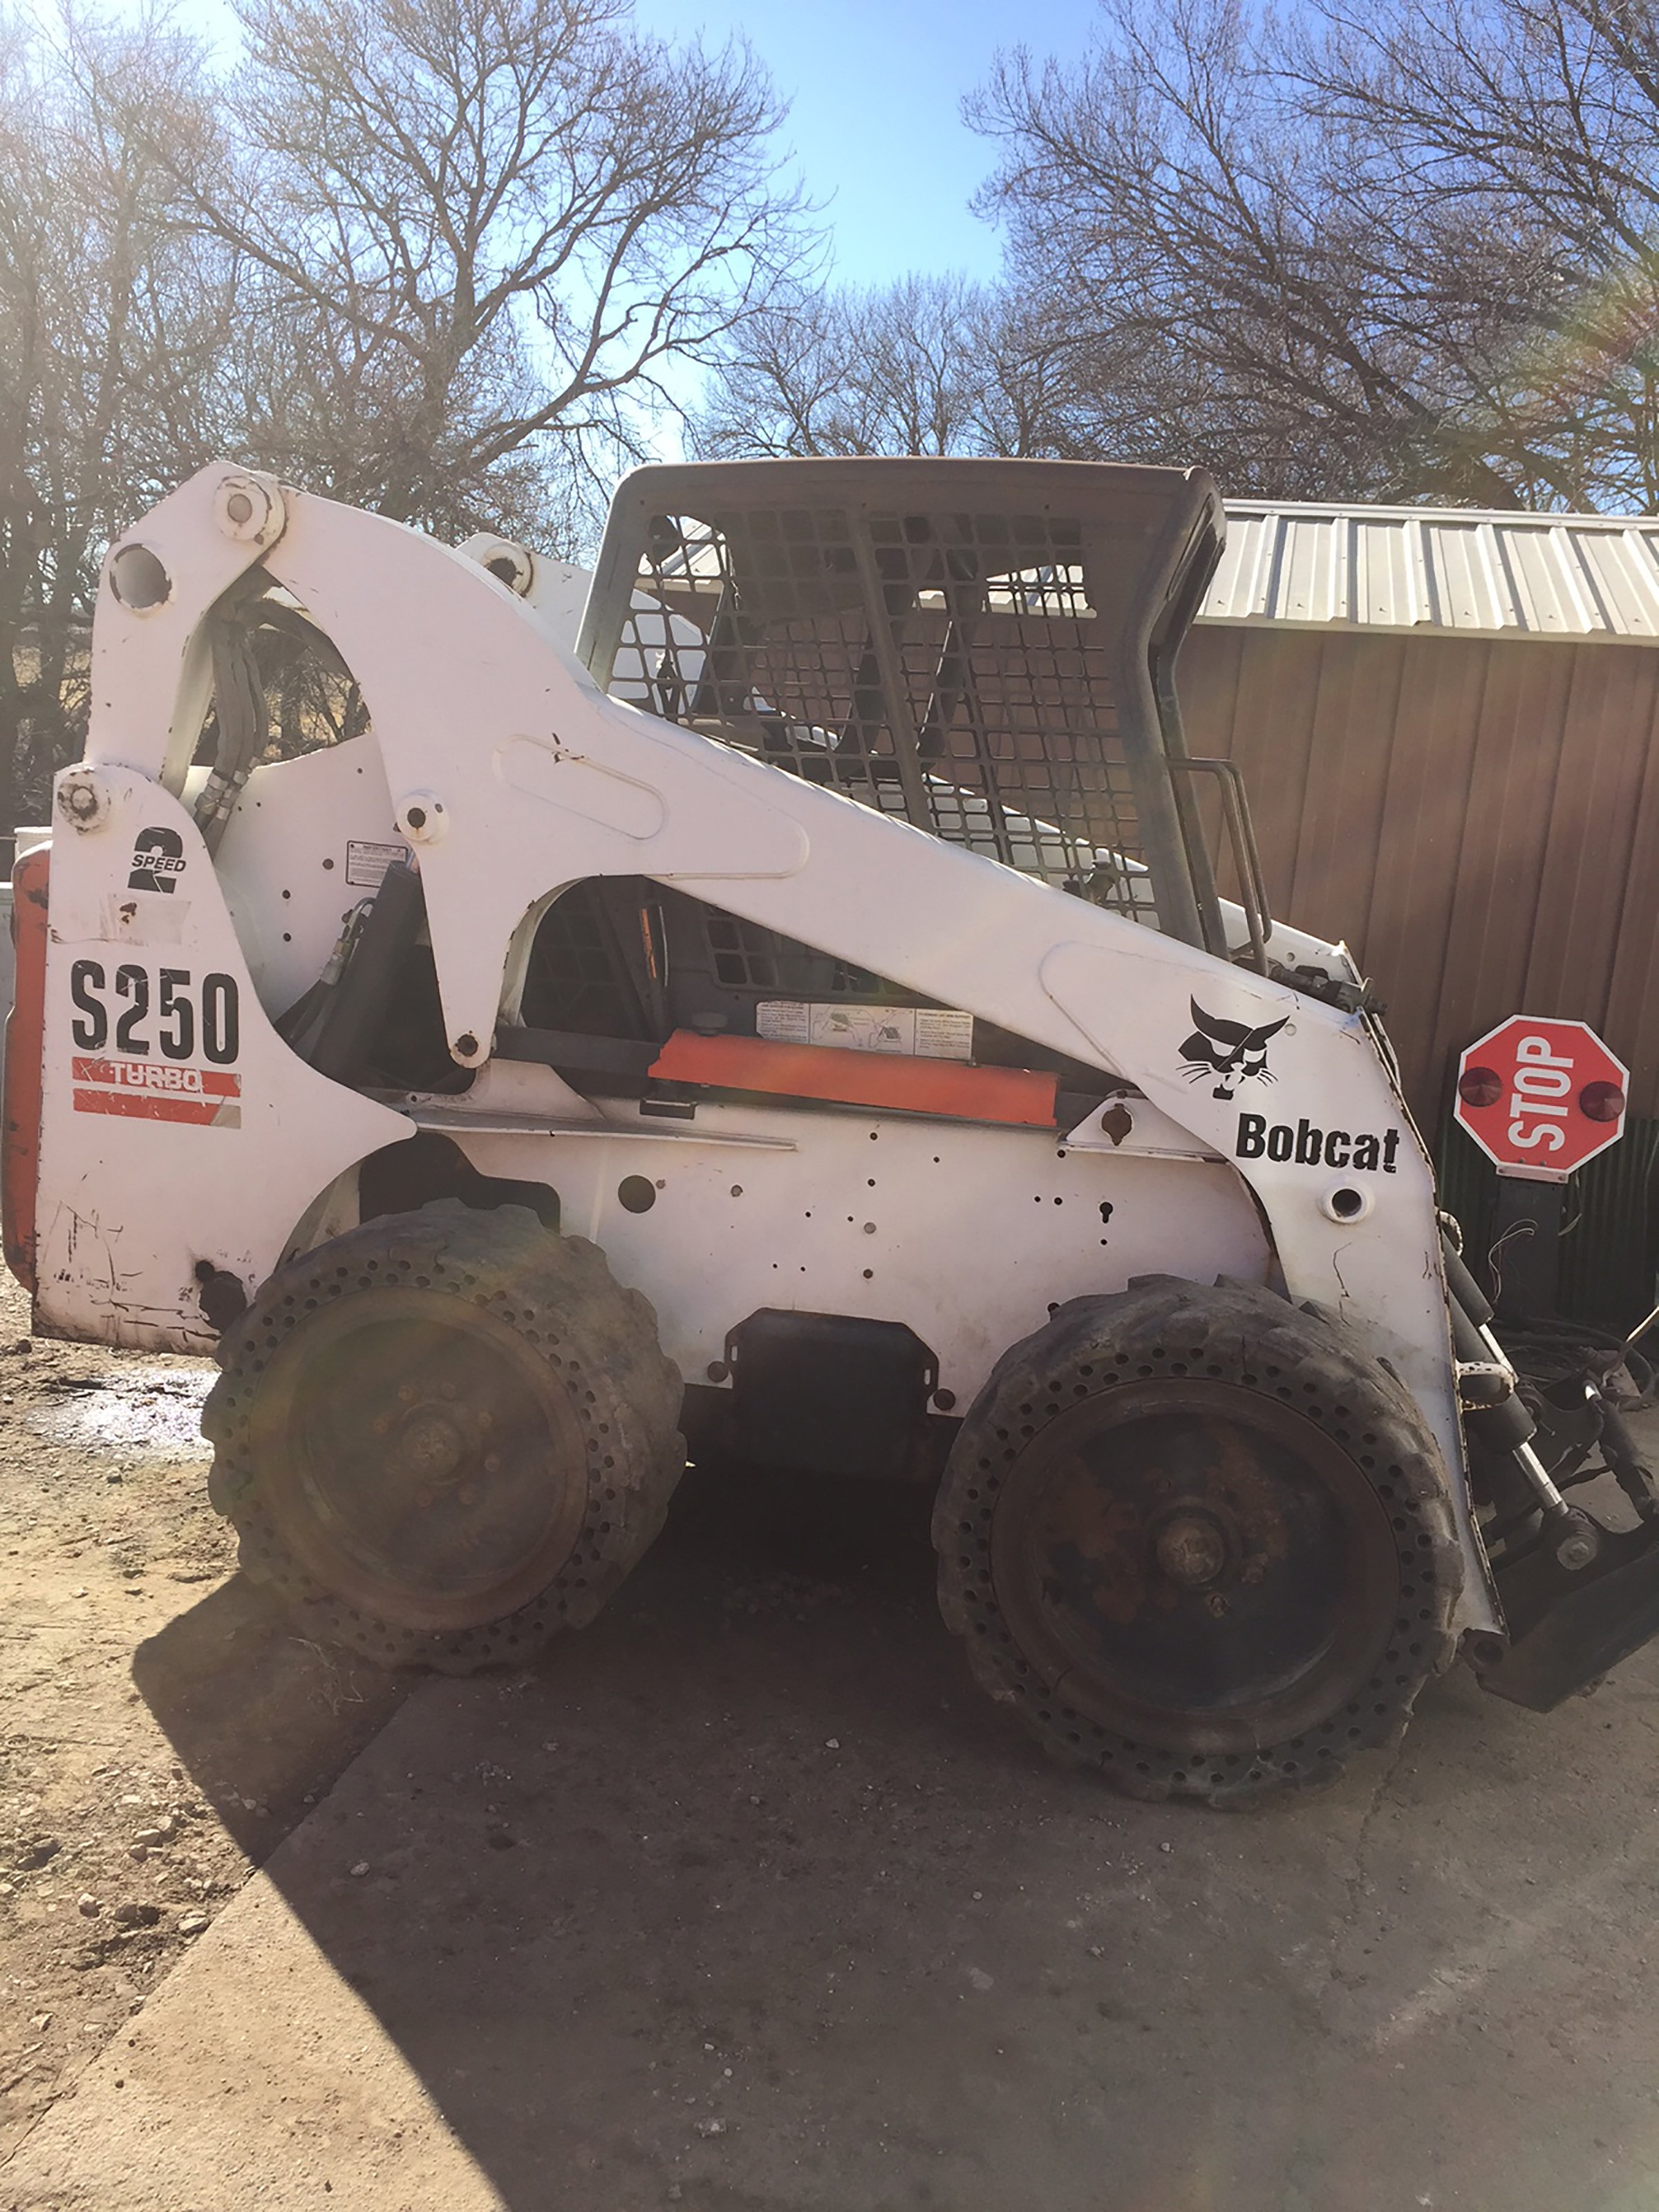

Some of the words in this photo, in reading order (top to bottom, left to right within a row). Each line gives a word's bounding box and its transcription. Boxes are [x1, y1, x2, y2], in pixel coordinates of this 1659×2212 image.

[127, 827, 182, 894] 2
[131, 854, 186, 872] SPEED
[71, 959, 239, 1065] S250
[109, 1062, 203, 1091] TURBO
[1508, 1035, 1574, 1152] STOP
[1236, 1113, 1400, 1174] Bobcat
